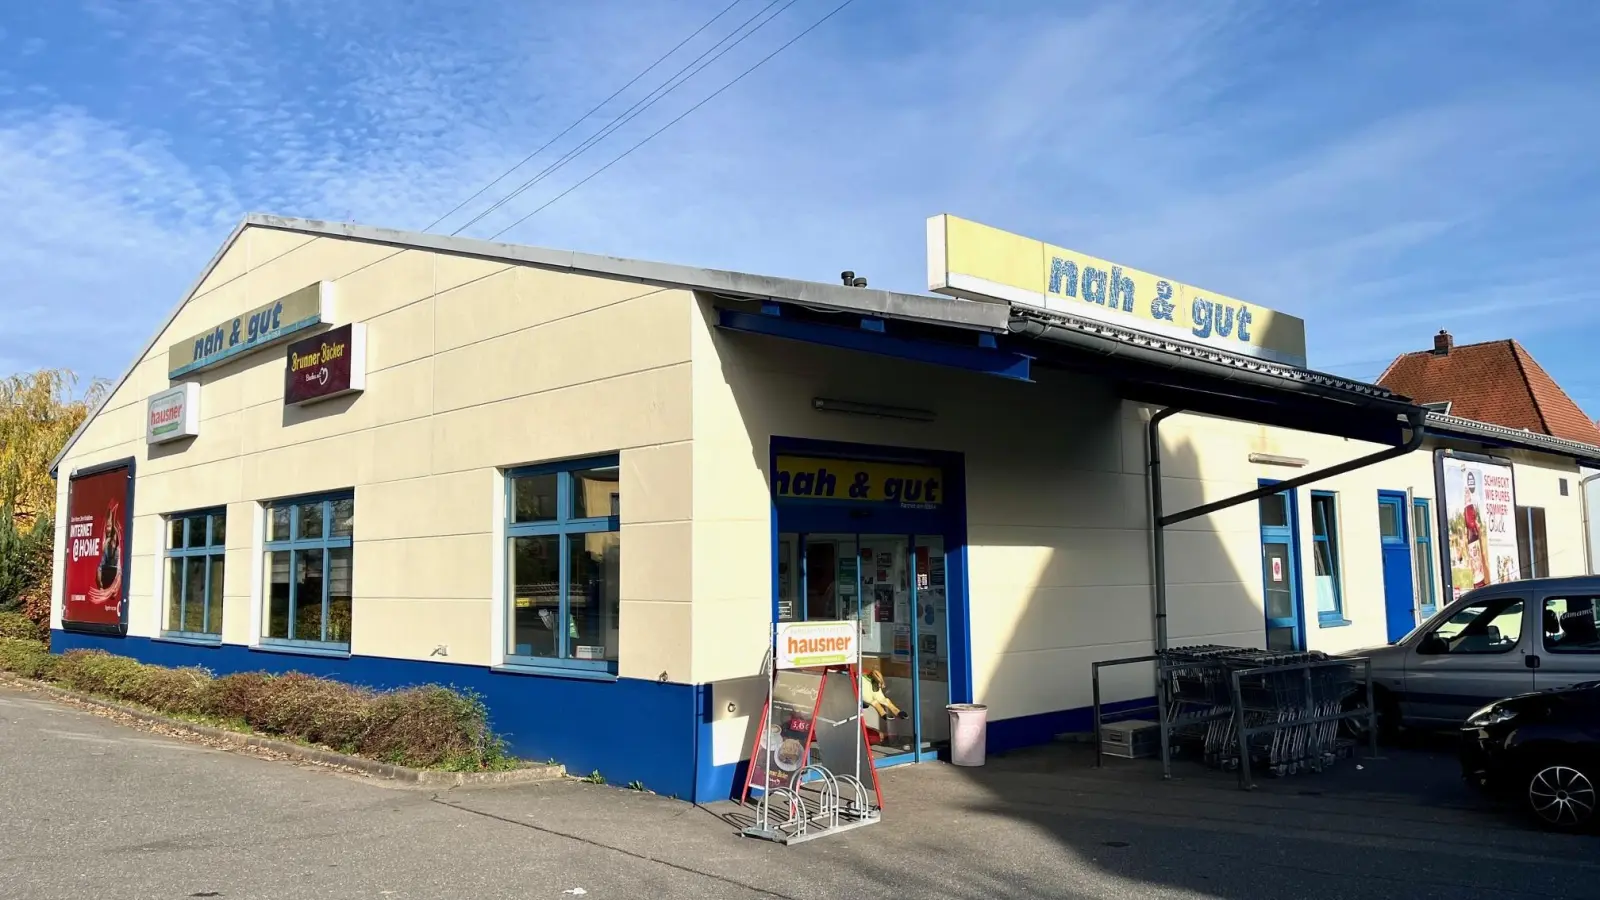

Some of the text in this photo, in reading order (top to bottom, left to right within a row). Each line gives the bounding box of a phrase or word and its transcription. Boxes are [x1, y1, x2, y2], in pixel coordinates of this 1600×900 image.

[1048, 256, 1252, 342] nah & gut
[193, 301, 283, 361] nah & gut
[291, 342, 345, 372] Brunner Bäcker
[150, 404, 183, 426] hausner
[776, 468, 939, 505] nah & gut
[1483, 474, 1510, 488] SCHMECKT
[1485, 489, 1510, 503] WIE PURES
[70, 522, 94, 538] INTERNET
[72, 537, 100, 562] @HOME
[787, 635, 852, 655] hausner
